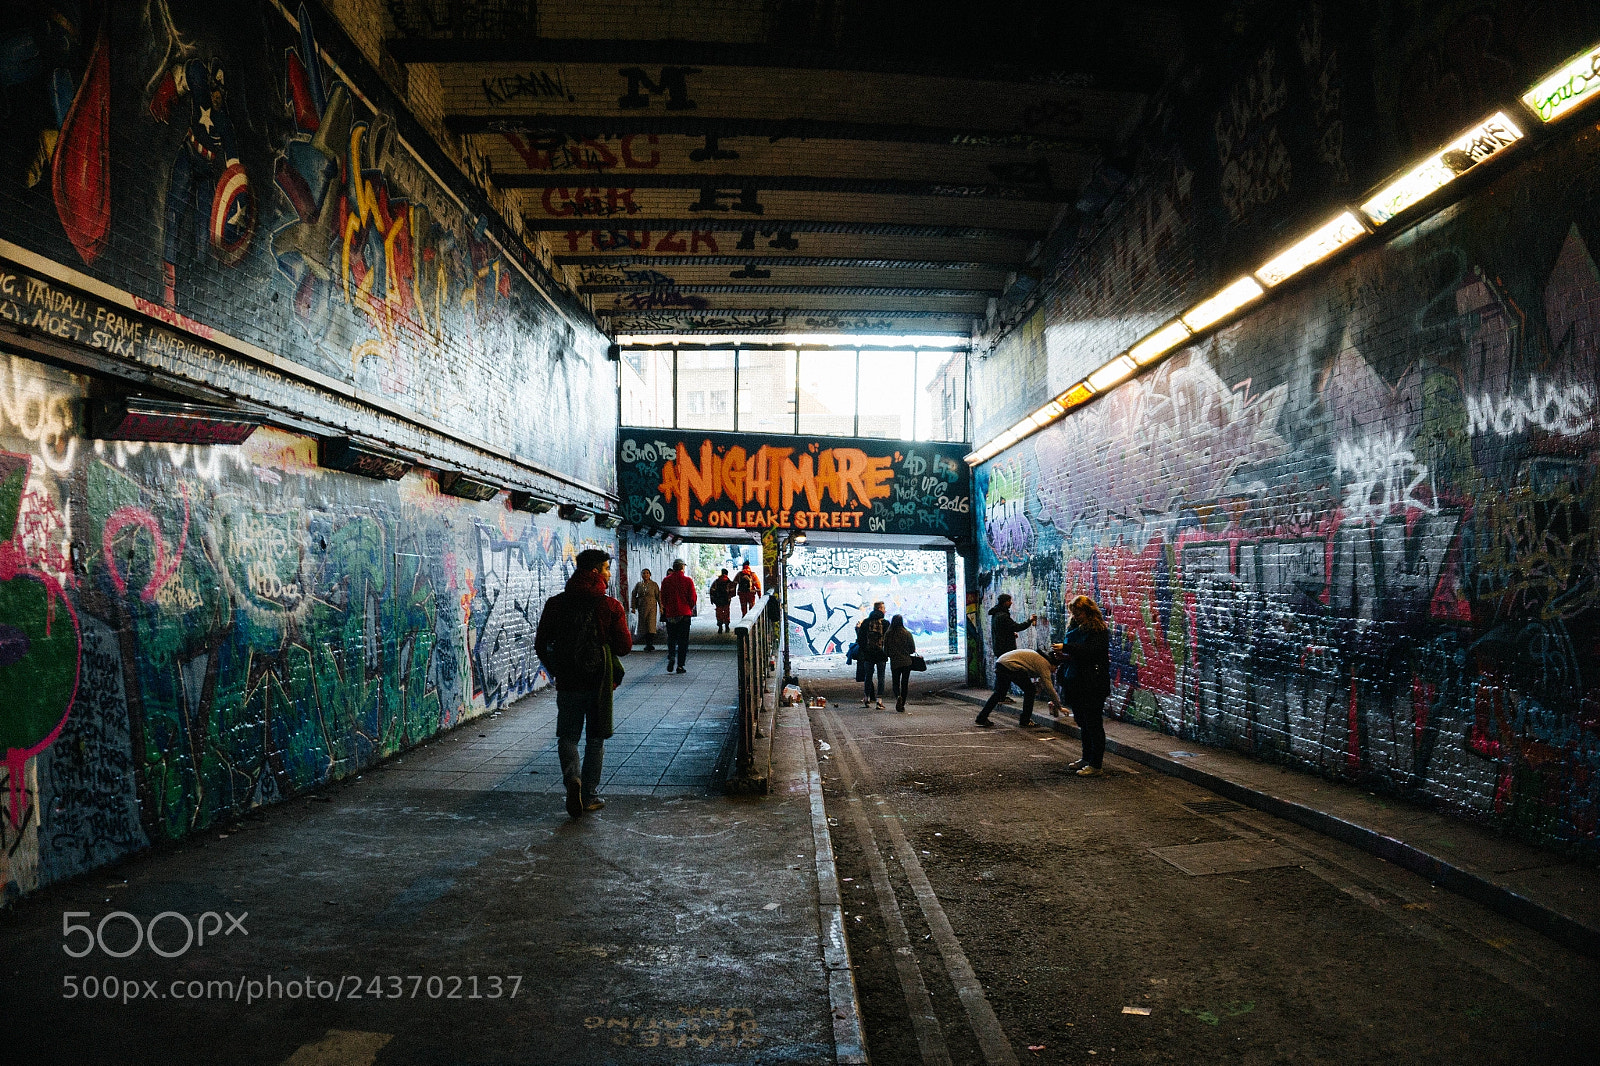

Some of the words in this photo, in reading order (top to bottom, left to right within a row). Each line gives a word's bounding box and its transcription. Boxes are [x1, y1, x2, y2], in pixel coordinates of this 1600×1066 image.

[676, 438, 895, 526] NIGHTMARE
[707, 511, 734, 528] ON
[737, 511, 791, 528] LEAKE
[794, 511, 864, 528] STREET
